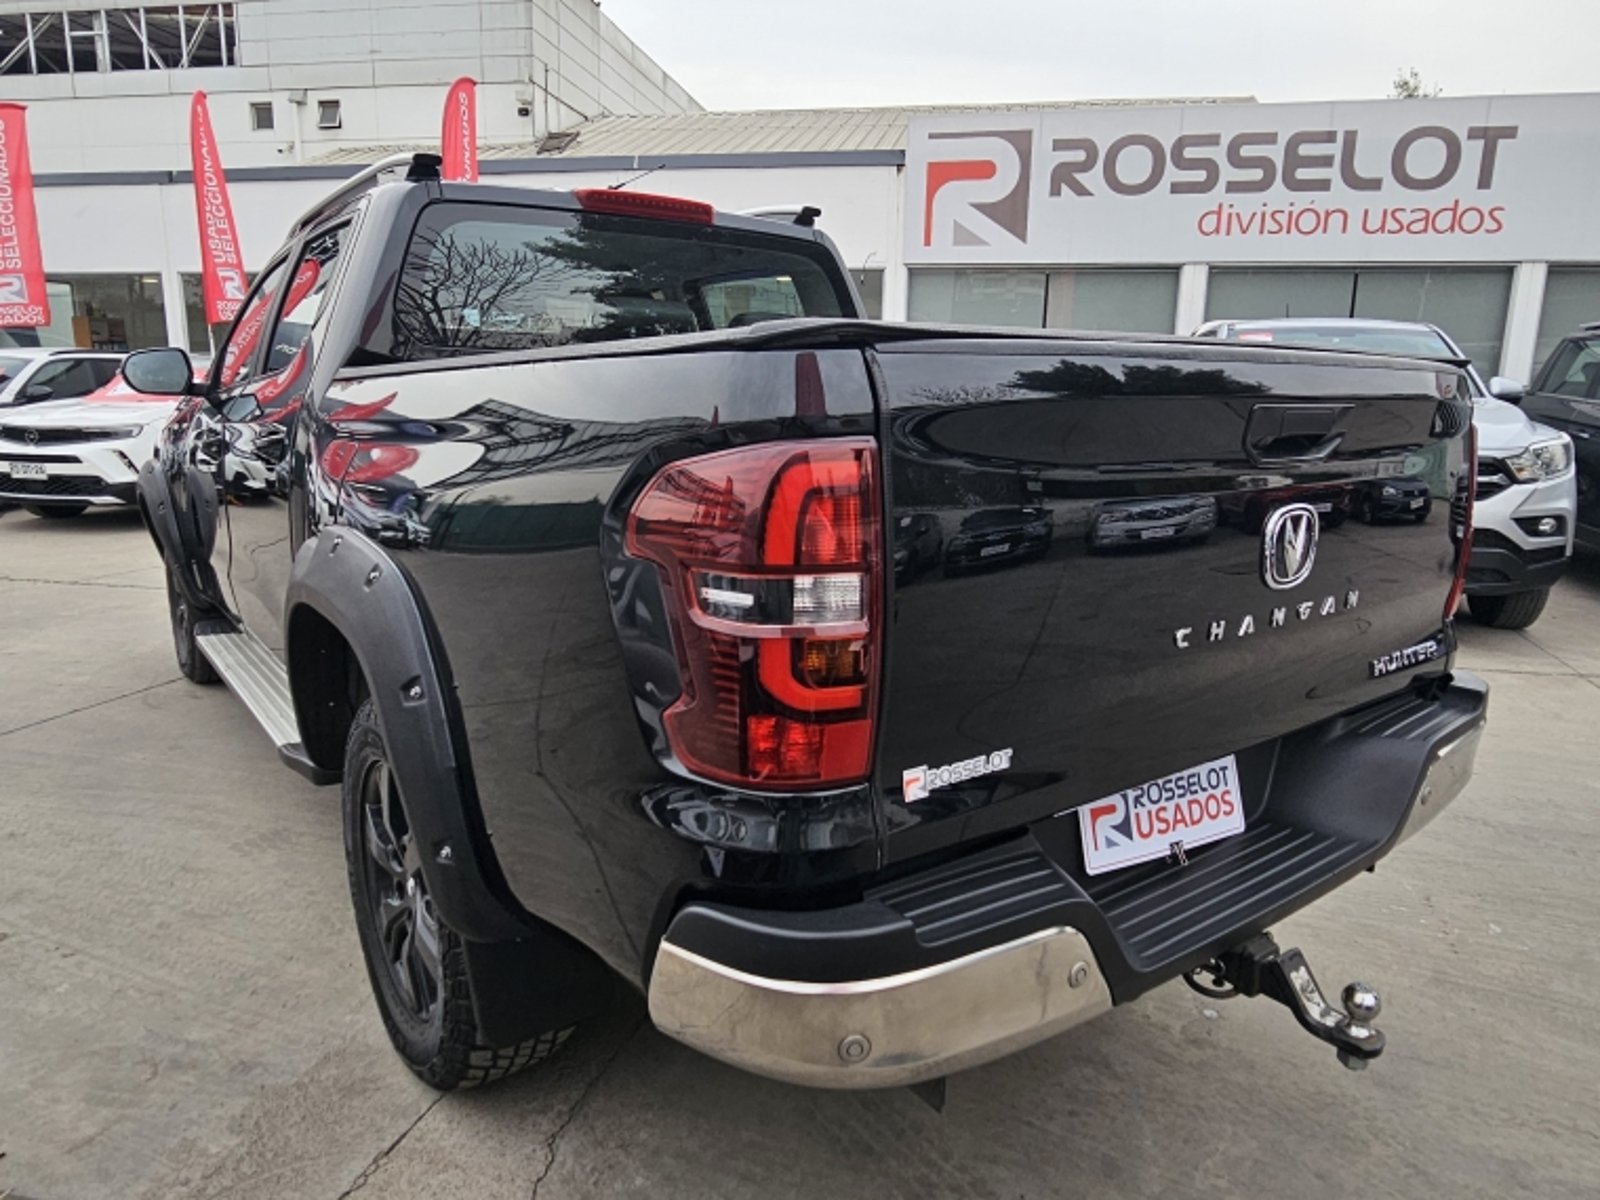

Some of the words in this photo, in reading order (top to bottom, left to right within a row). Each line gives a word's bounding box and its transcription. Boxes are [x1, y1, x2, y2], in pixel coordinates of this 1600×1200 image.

[1048, 125, 1518, 198] ROSSELOT
[1197, 200, 1349, 238] división
[1361, 198, 1506, 236] usados
[1174, 590, 1359, 648] CHANGAN
[1373, 640, 1438, 677] HUNTER
[928, 749, 1012, 789] ROSSELOT
[1133, 766, 1228, 809] ROSSELOT
[1135, 790, 1235, 839] USADOS
